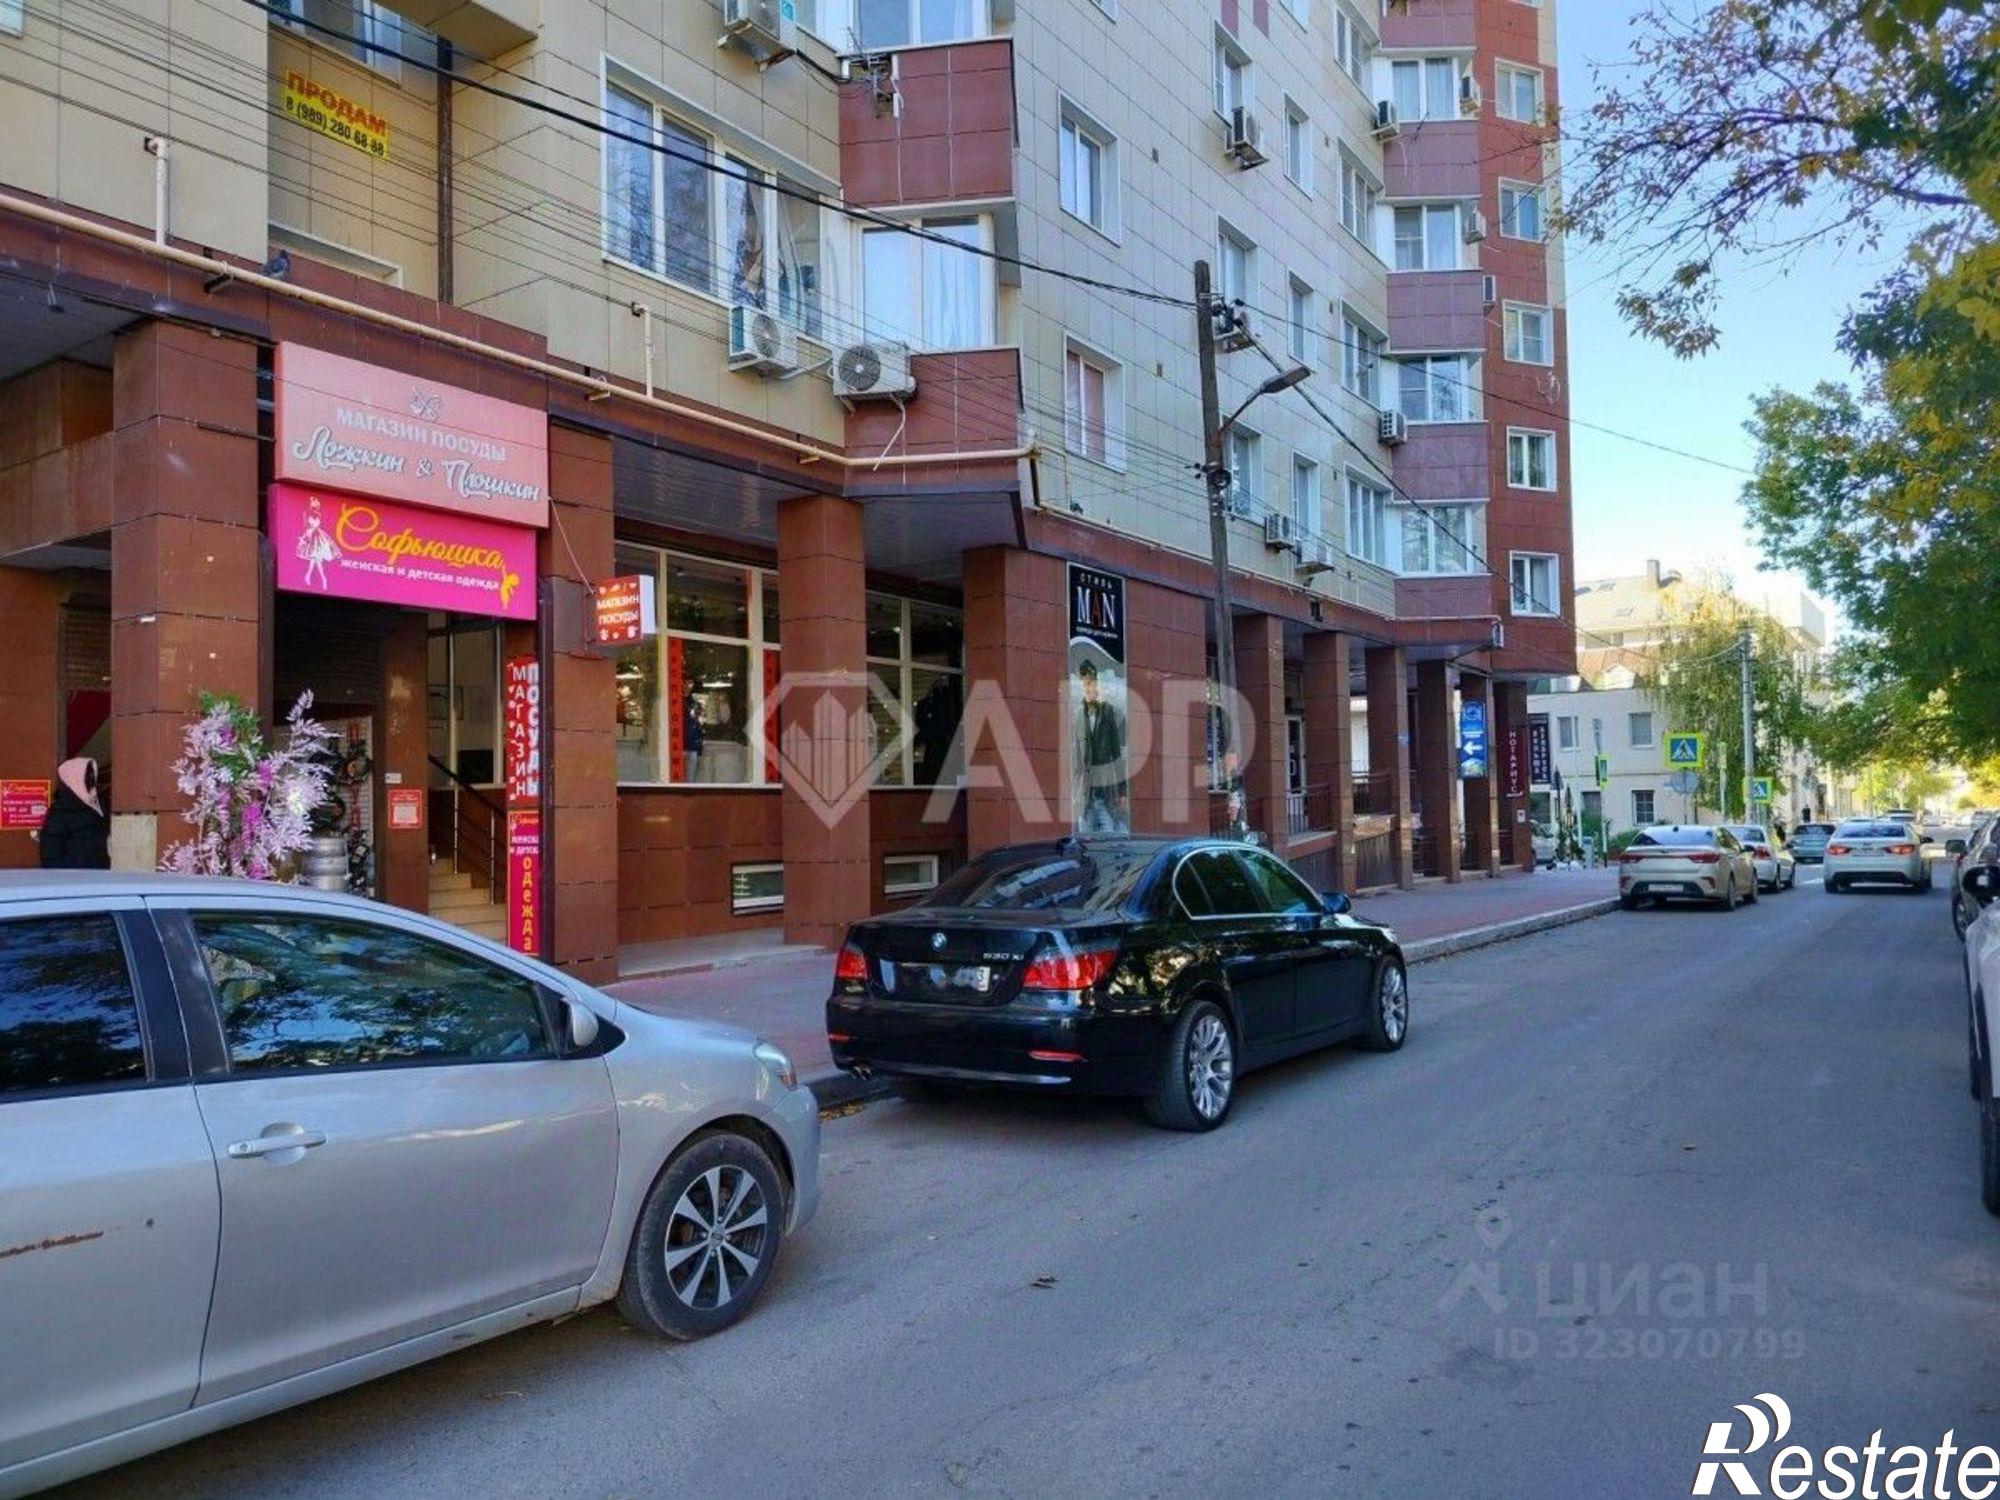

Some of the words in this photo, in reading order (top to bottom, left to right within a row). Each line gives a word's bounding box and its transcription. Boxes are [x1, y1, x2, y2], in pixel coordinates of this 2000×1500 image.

[287, 71, 386, 137] ПРОДАМ
[292, 425, 405, 472] Ложкин
[416, 457, 433, 478] &
[442, 459, 540, 500] Плюшкин
[337, 407, 426, 444] МАГАЗИН
[432, 430, 507, 462] ПОСУДЫ
[336, 503, 502, 566] Софьюшка
[341, 559, 394, 575] женская
[397, 566, 406, 576] и
[408, 567, 453, 583] детская
[456, 573, 500, 591] одежда
[596, 594, 640, 610] МАГАЗИН
[598, 610, 639, 625] ПОСУДЫ
[1077, 586, 1116, 629] MAN
[512, 666, 526, 796] МАГАЗИН
[1508, 731, 1518, 792] НОТАРИУС
